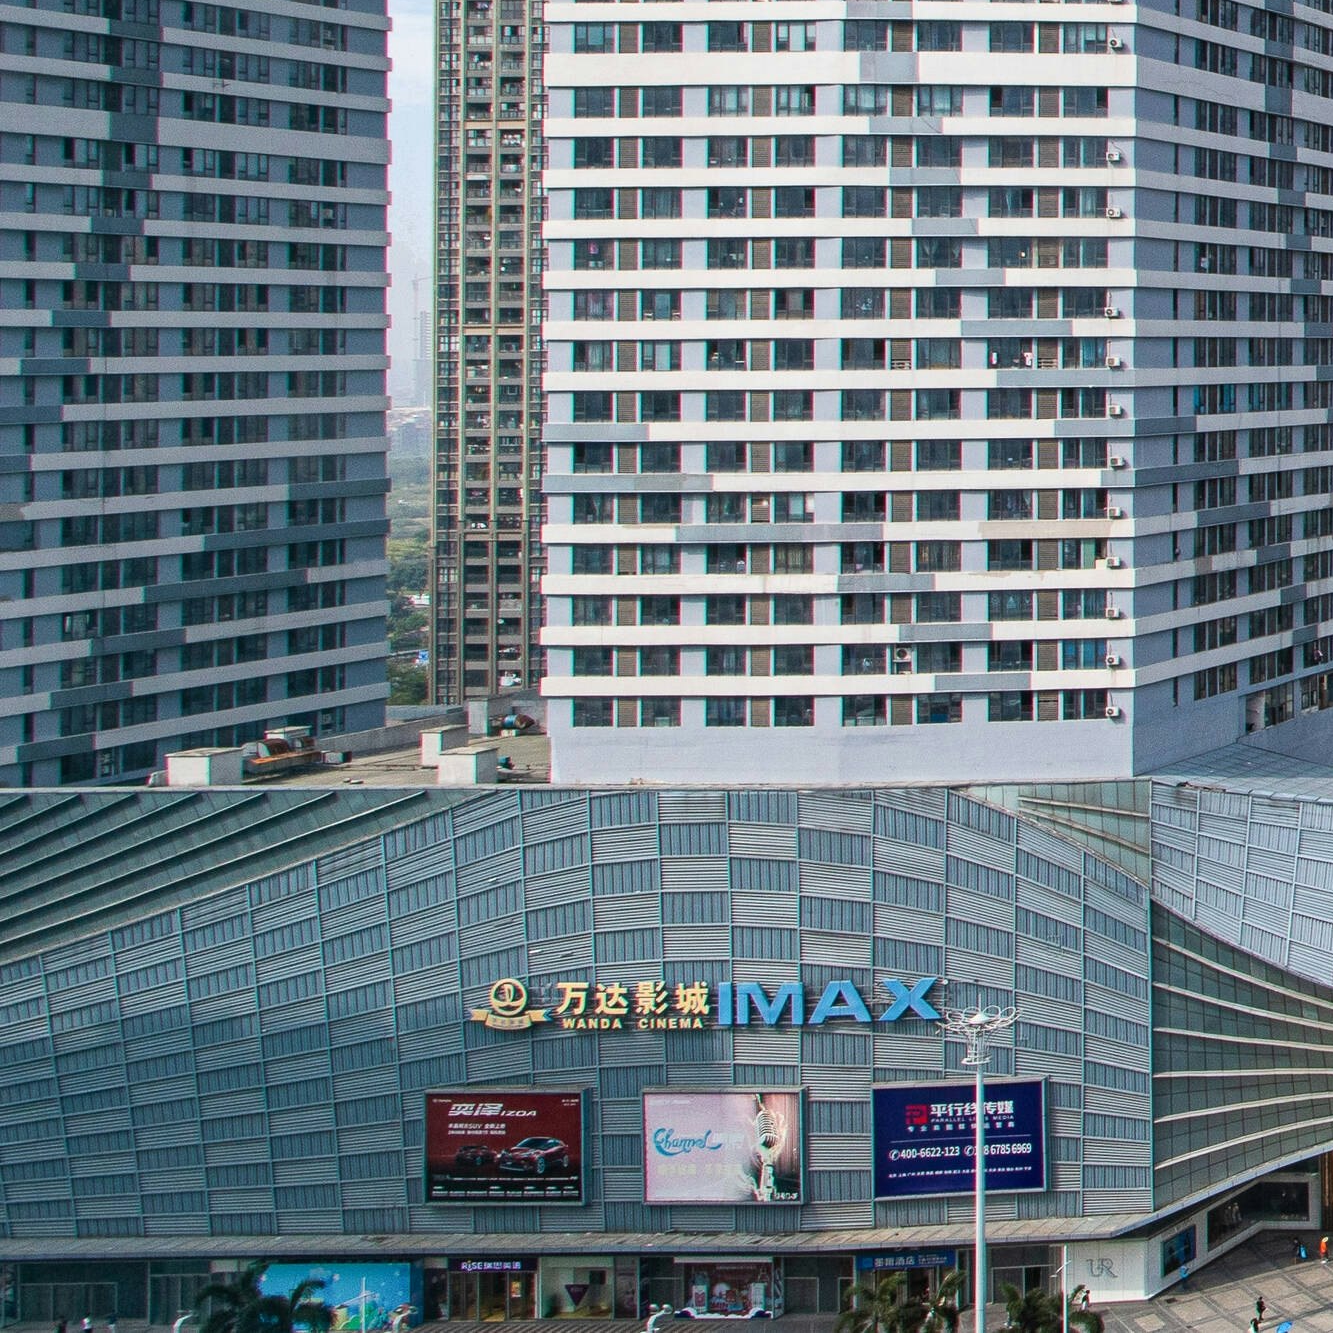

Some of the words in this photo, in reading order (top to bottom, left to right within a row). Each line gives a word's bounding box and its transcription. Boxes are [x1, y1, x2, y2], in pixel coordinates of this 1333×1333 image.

[556, 981, 710, 1015] 万达影城
[718, 977, 944, 1025] IMAX
[561, 1018, 623, 1029] WANDA
[638, 1017, 703, 1029] CINEMA
[900, 1146, 960, 1159] 400-6622-123
[990, 1144, 1011, 1155] 6785
[1012, 1142, 1032, 1154] 6969
